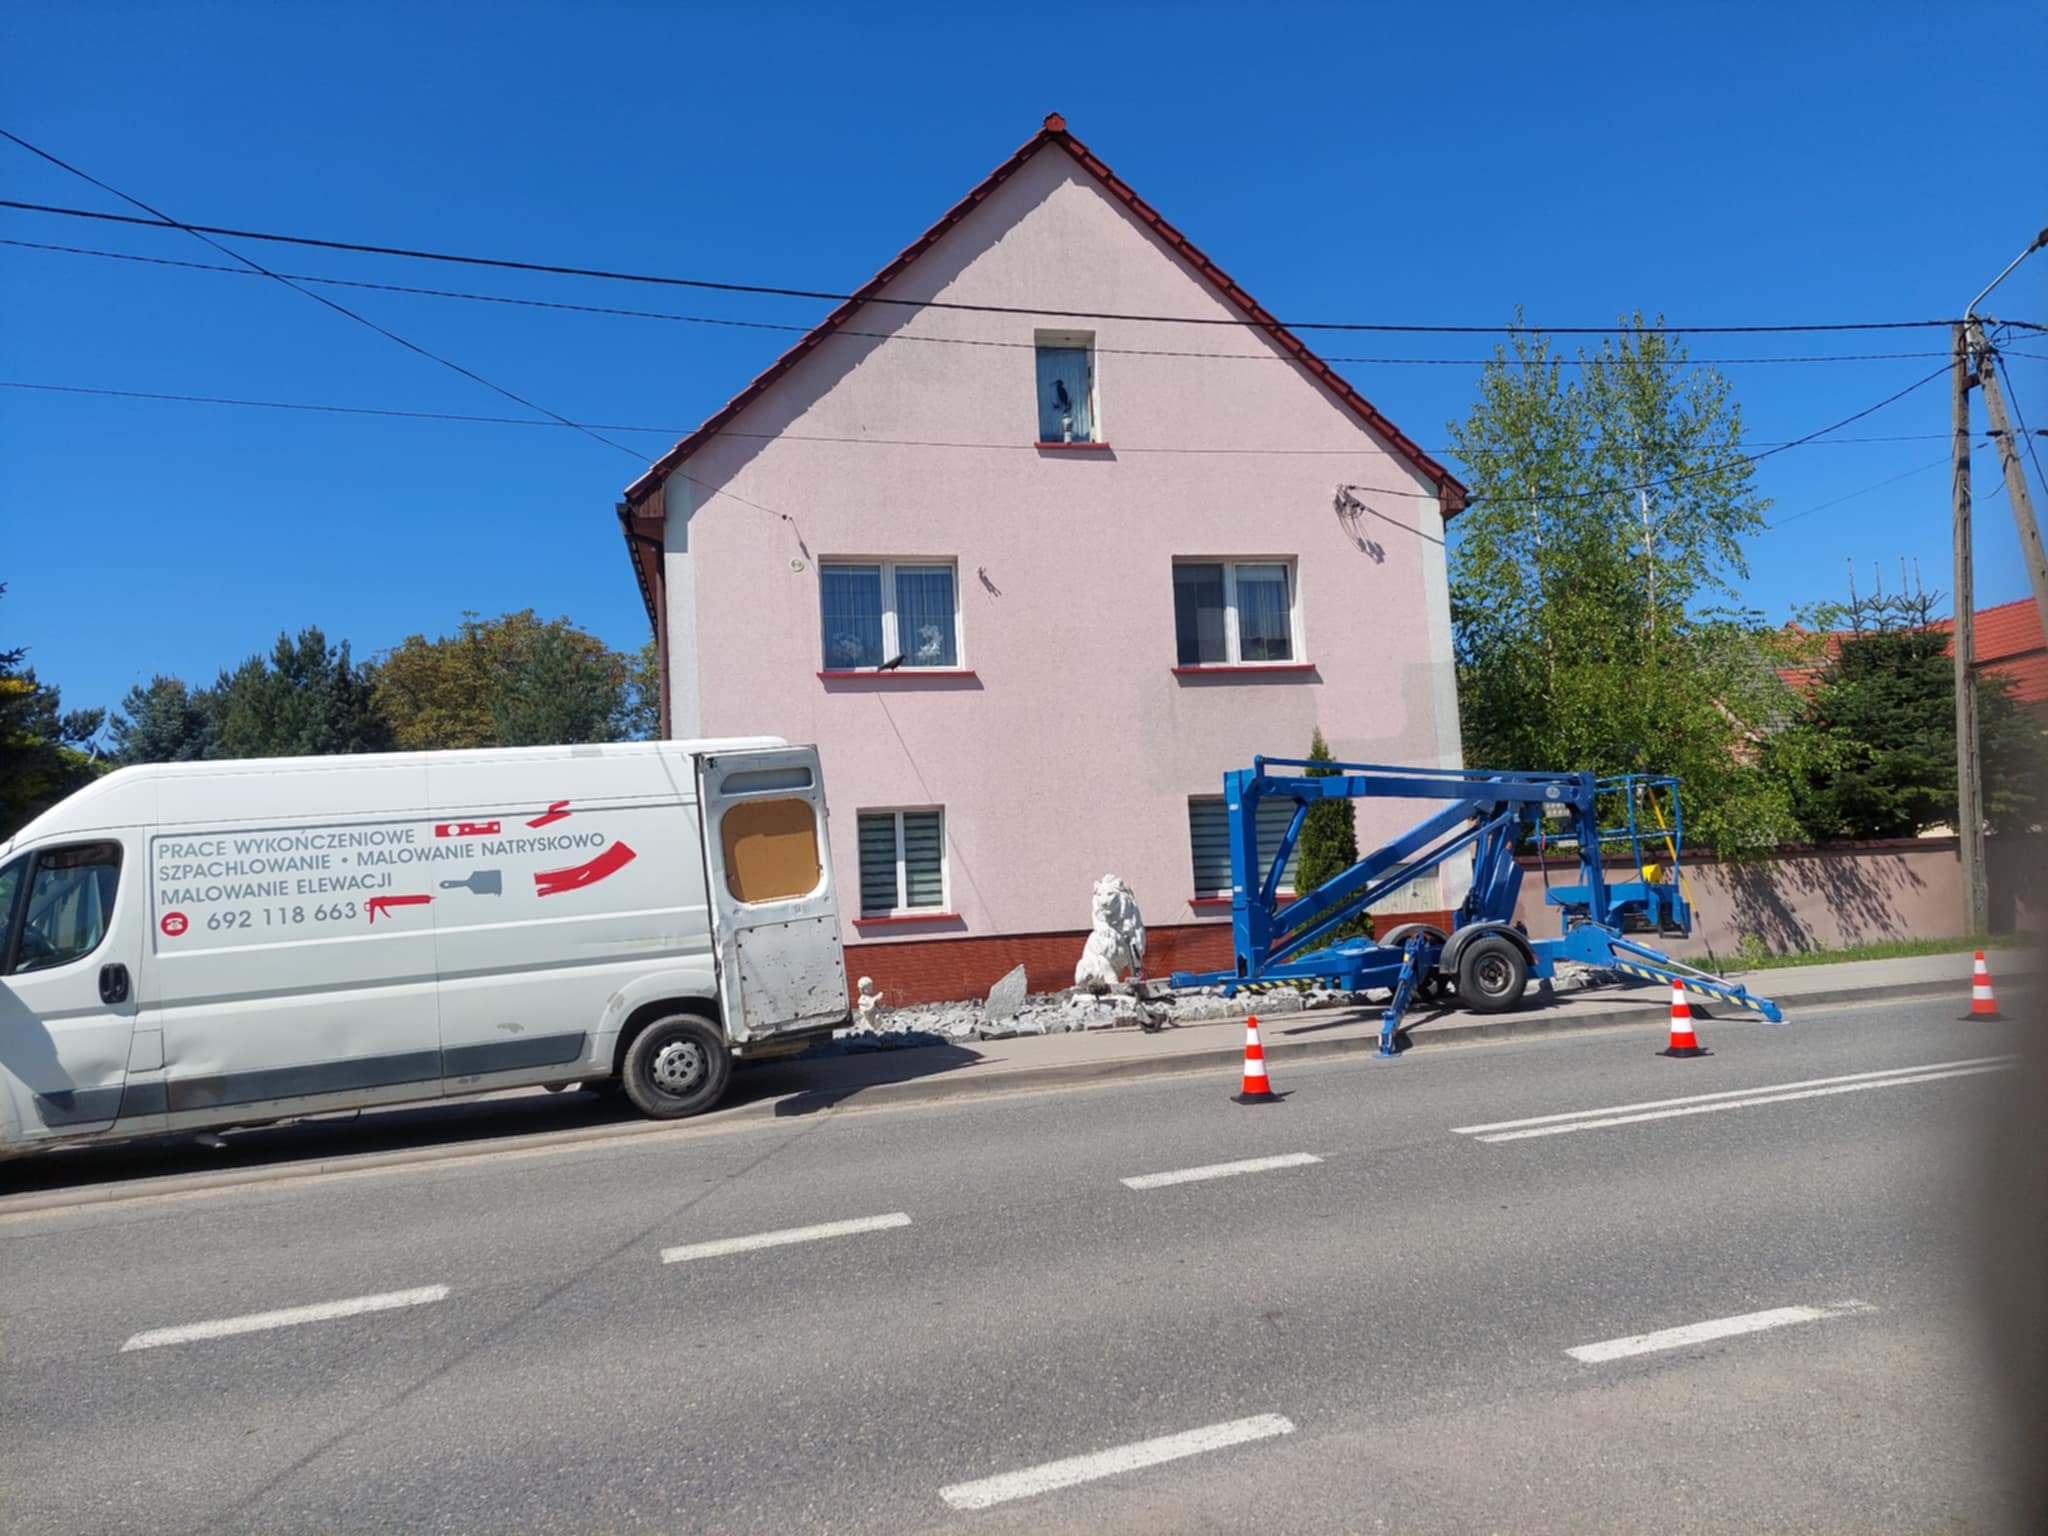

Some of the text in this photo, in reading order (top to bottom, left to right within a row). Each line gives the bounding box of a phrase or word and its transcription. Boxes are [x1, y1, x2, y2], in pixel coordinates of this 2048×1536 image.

[159, 830, 414, 859] PRACE WYKOŃCZENIOWE
[159, 832, 605, 881] SZPACHLOWANIE MALOWANIE NATRYSKOWO
[161, 872, 391, 905] MALOWANIE ELEWACJI
[207, 902, 357, 930] 692 118 663
